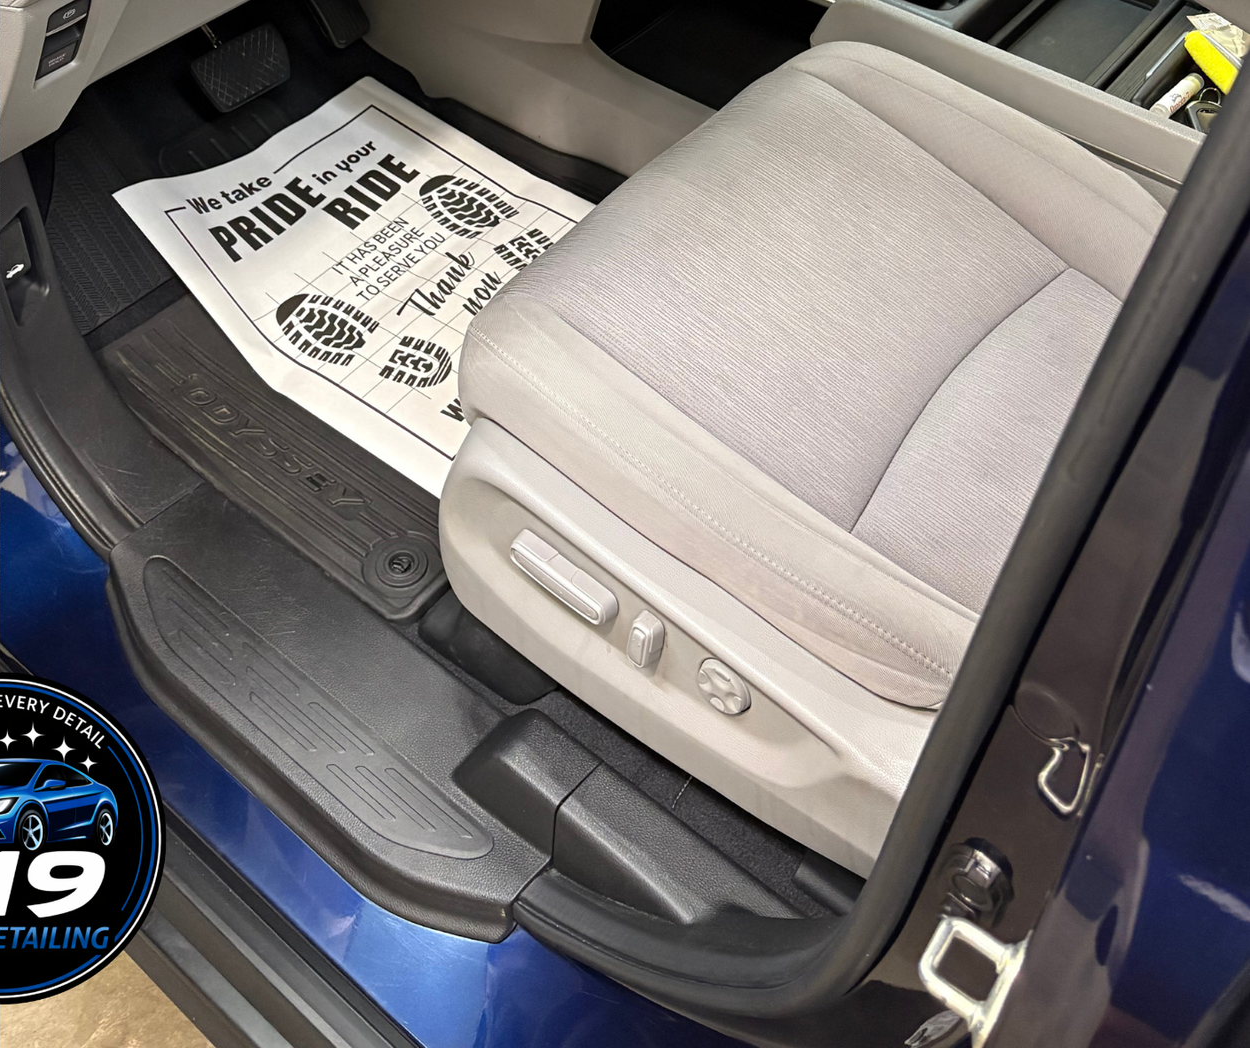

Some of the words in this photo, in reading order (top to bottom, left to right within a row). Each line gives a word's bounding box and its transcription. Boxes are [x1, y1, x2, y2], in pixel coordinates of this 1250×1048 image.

[186, 196, 223, 214] We
[220, 176, 273, 203] take
[208, 176, 327, 263] PRIDE
[311, 170, 338, 185] in
[335, 140, 377, 173] your
[322, 153, 421, 230] RIDE
[331, 261, 350, 275] IT
[345, 241, 377, 264] HAS
[373, 216, 409, 244] BEEN
[349, 275, 365, 287] A
[358, 227, 425, 278] PLEASURE
[356, 284, 380, 301] TO
[376, 253, 421, 288] SERVE
[414, 232, 446, 255] YOU
[396, 251, 475, 316] Thank
[462, 271, 502, 316] you
[183, 386, 371, 506] ODYSSEY
